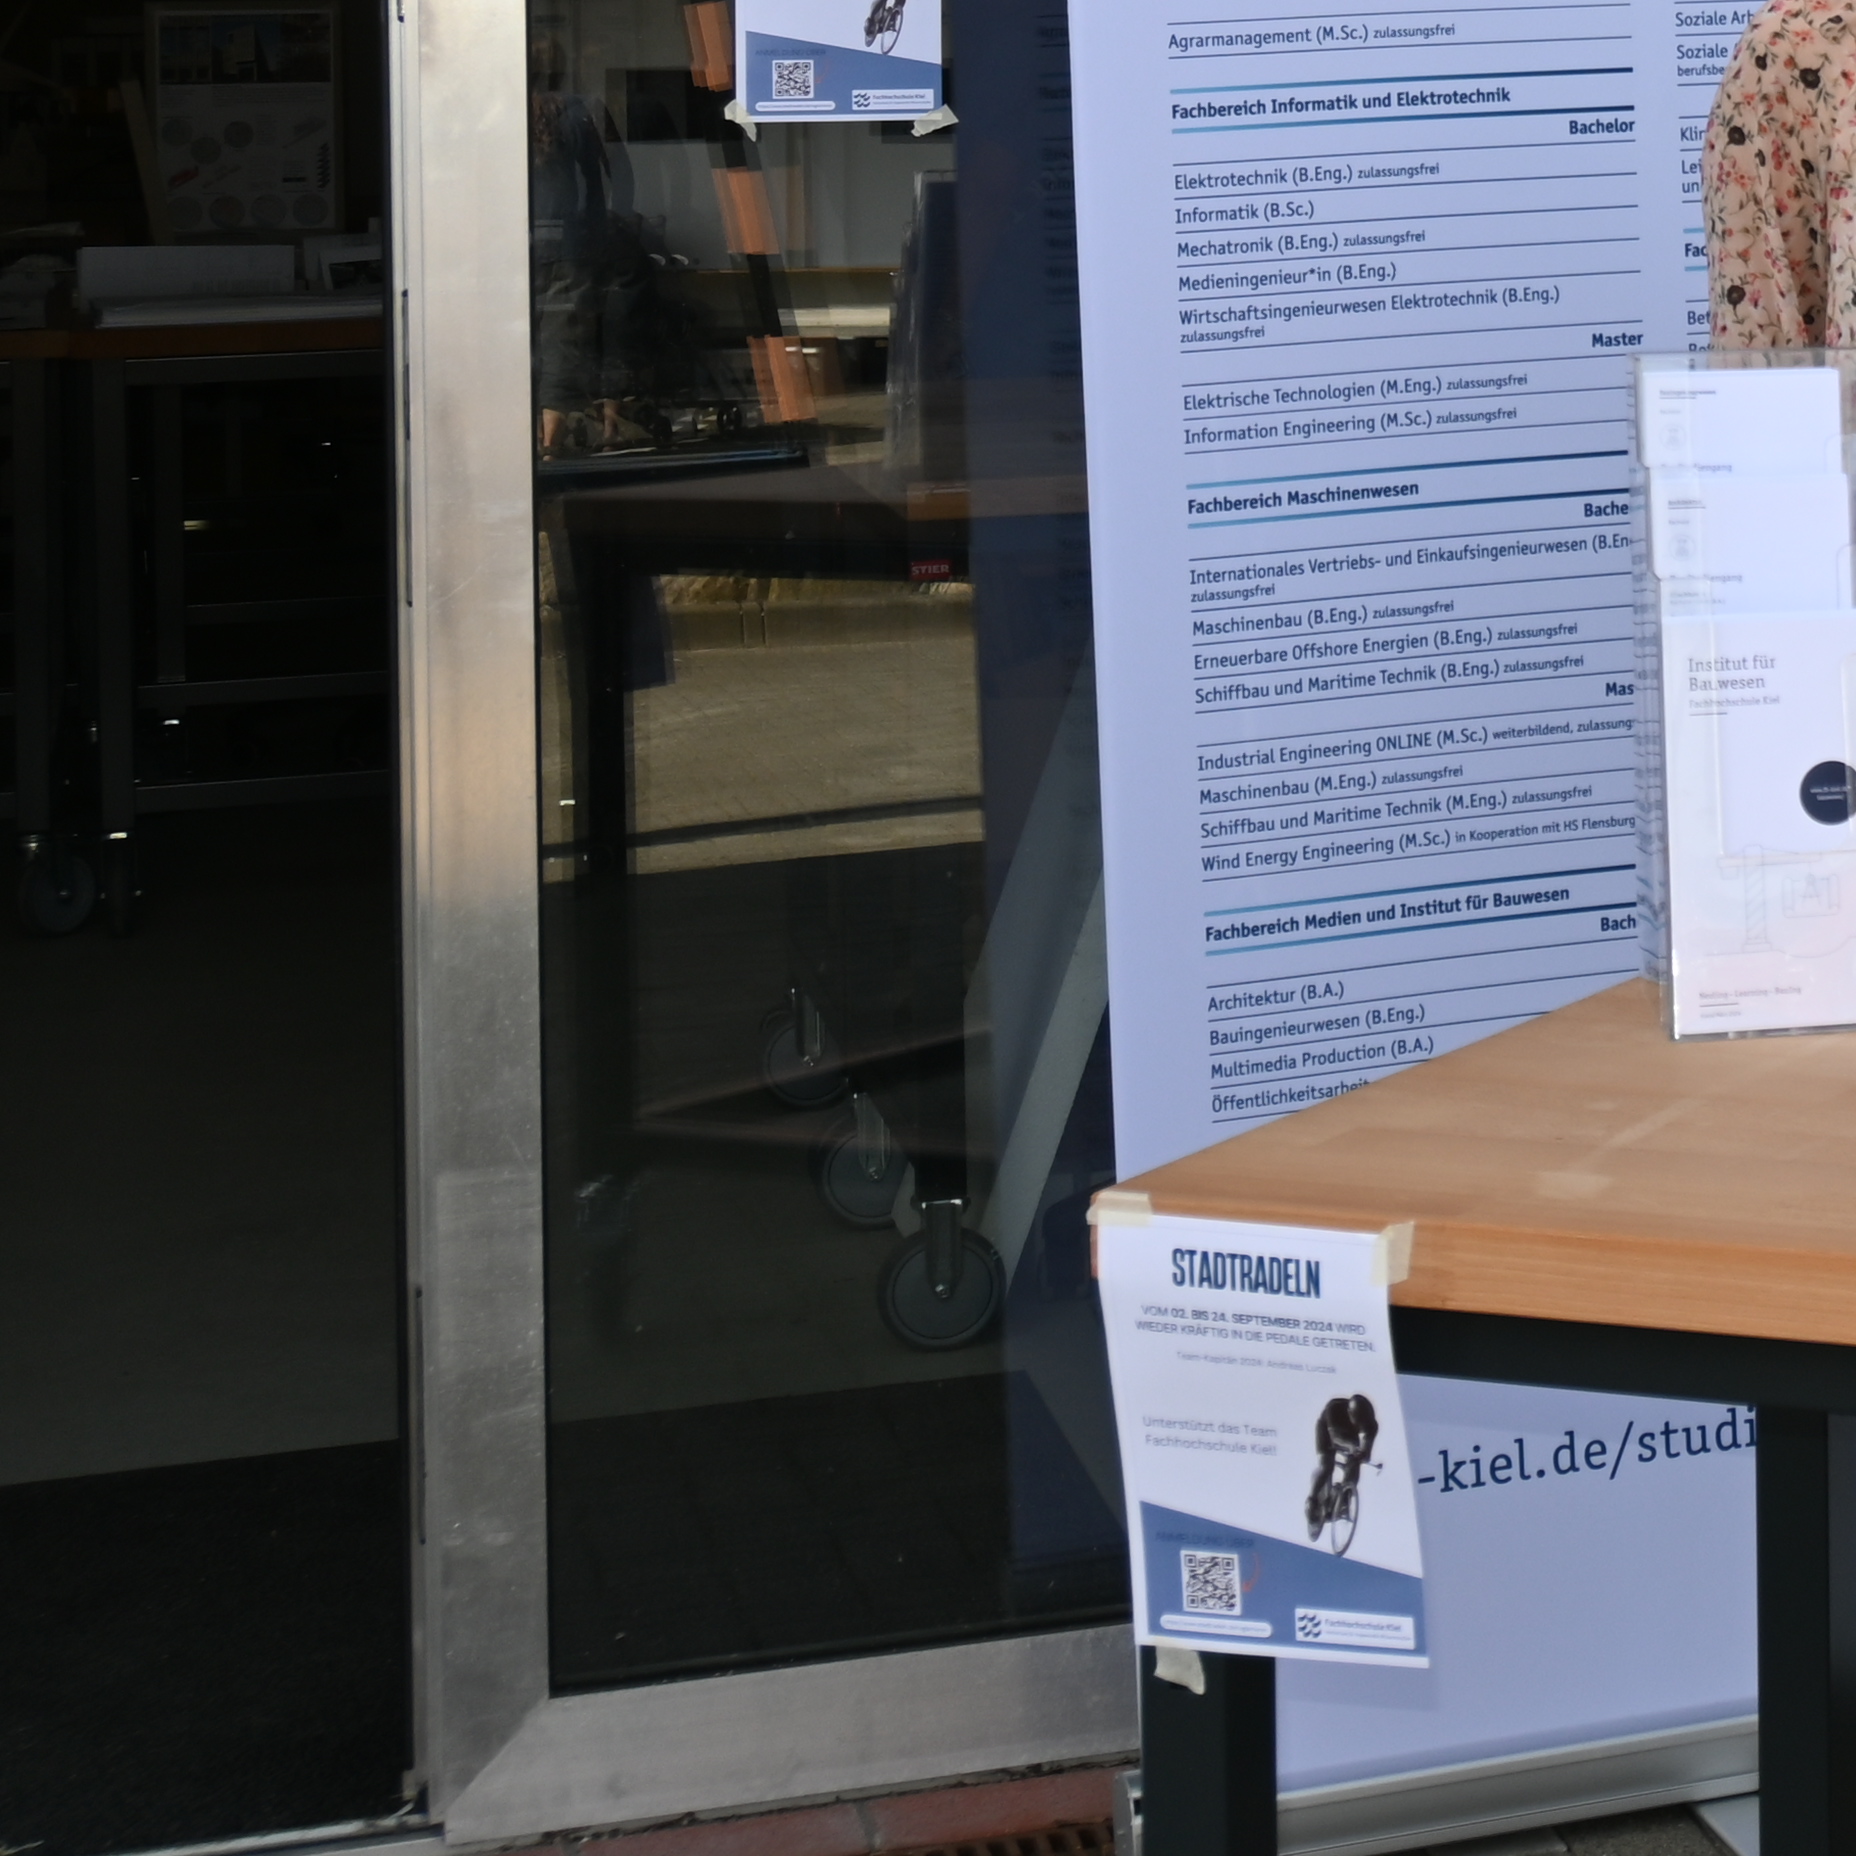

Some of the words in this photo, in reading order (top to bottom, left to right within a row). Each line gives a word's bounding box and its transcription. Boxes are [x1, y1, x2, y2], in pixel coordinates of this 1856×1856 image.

[1675, 10, 1727, 27] Soziale
[1168, 28, 1312, 52] Agrarmanagement
[1316, 24, 1368, 45] (M.Sc.)
[1172, 99, 1266, 119] Fachbereich
[1271, 94, 1358, 114] Informatik
[1362, 92, 1392, 109] und
[1397, 87, 1511, 107] Elektrotechnik
[1569, 118, 1635, 135] Bachelor
[1175, 168, 1288, 190] Elektrotechnik
[1292, 164, 1353, 187] (B.Eng.)
[1357, 162, 1440, 179] zulassungsfrei
[1175, 204, 1259, 224] Informatik
[1264, 200, 1314, 222] (B.Sc.)
[1177, 236, 1273, 257] Mechatronik
[1278, 232, 1338, 255] (B.Eng.)
[1337, 261, 1396, 285] (B.Eng.)
[1179, 300, 1386, 325] Wirtschaftsingenieurwesen
[1391, 289, 1498, 310] Elektrotechnik
[1502, 285, 1560, 307] (B.Eng.)
[1180, 325, 1265, 343] zulassungsfrei
[1592, 332, 1643, 348] Master
[1184, 390, 1270, 410] Elektrische
[1273, 382, 1375, 403] Technologien
[1380, 376, 1442, 399] (M.Eng.)
[1184, 423, 1278, 444] Information
[1283, 415, 1375, 439] Engineering
[1380, 410, 1432, 432] (M.Sc.)
[1436, 407, 1517, 424] zulassungsfrei
[1188, 492, 1282, 514] Fachbereich
[1287, 484, 1419, 506] Maschinenwesen
[1190, 561, 1305, 585] Internationales
[1308, 554, 1381, 573] Vertriebs-
[1385, 549, 1412, 567] und
[1417, 539, 1587, 564] Einkaufsingenieurwesen
[1193, 613, 1302, 636] Maschinenbau
[1307, 605, 1368, 629] (B.Eng.)
[1372, 600, 1454, 619] zulassungsfrei
[1194, 649, 1288, 670] Erneuerbare
[1292, 642, 1358, 660] Offshore
[1363, 633, 1428, 654] Energien
[1433, 626, 1492, 650] (B.Eng.)
[1195, 684, 1269, 704] Schiffbau
[1274, 678, 1303, 696] und
[1308, 673, 1376, 692] Maritime
[1379, 665, 1436, 684] Technik
[1441, 659, 1500, 683] (B.Eng.)
[1503, 655, 1584, 673] zulassungsfrei
[1198, 748, 1275, 771] Industrial
[1280, 740, 1372, 764] Engineering
[1376, 731, 1432, 752] ONLINE
[1437, 726, 1488, 749] (M.Sc.)
[1492, 722, 1574, 740] weiterbildend,
[1200, 780, 1309, 804] Maschinenbau
[1314, 771, 1377, 796] (M.Eng.)
[1201, 818, 1275, 838] Schiffbau
[1280, 811, 1308, 830] und
[1314, 806, 1382, 825] Maritime
[1385, 797, 1442, 817] Technik
[1446, 790, 1507, 815] (M.Eng.)
[1512, 785, 1592, 804] zulassungsfrei
[1201, 853, 1240, 871] Wind
[1246, 850, 1298, 867] Energy
[1302, 837, 1394, 862] Engineering
[1399, 829, 1451, 853] (M.Sc.)
[1455, 831, 1466, 842] in
[1469, 825, 1539, 842] Kooperation
[1542, 821, 1561, 833] mit
[1563, 819, 1579, 832] HS
[1581, 816, 1636, 830] Flensburg
[1206, 916, 1299, 942] Fachbereich
[1305, 911, 1361, 930] Medien
[1366, 904, 1396, 923] und
[1400, 898, 1462, 918] Institut
[1465, 895, 1489, 911] für
[1493, 889, 1570, 908] Bauwesen
[1208, 990, 1296, 1012] Architektur
[1301, 980, 1344, 1004] (B.A.)
[1210, 1016, 1360, 1046] Bauingenieurwesen
[1365, 1003, 1425, 1029] (B.Eng.)
[1211, 1054, 1297, 1079] Multimedia
[1302, 1044, 1385, 1067] Production
[1391, 1035, 1434, 1059] (B.A.)
[1172, 1248, 1320, 1298] STADTRADELN
